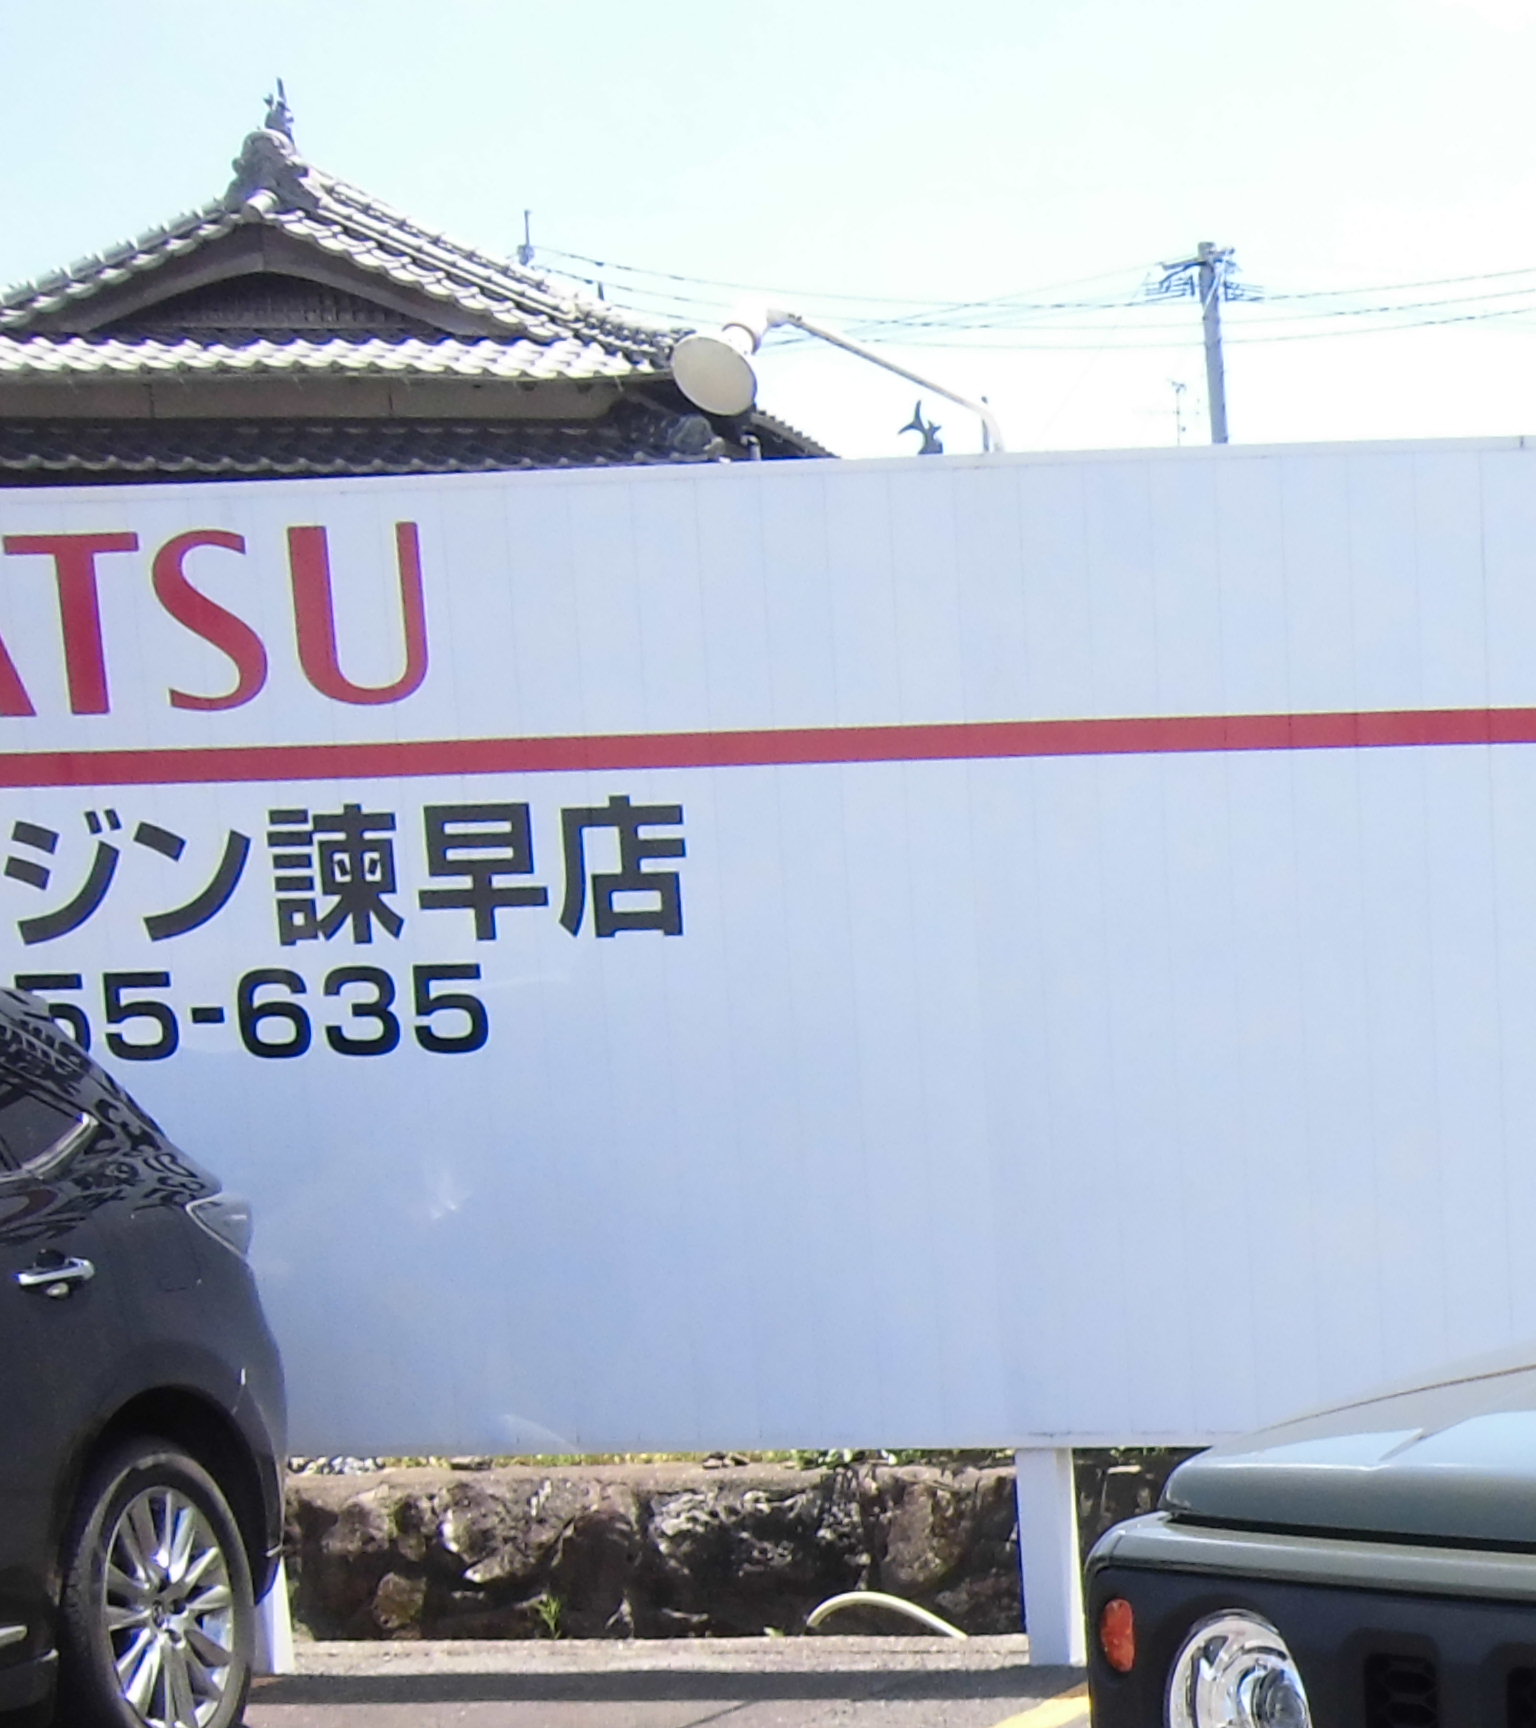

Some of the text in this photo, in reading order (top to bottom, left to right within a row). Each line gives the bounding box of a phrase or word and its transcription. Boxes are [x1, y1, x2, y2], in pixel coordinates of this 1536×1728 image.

[0, 522, 429, 717] TSU
[4, 795, 687, 947] ジン諫早店
